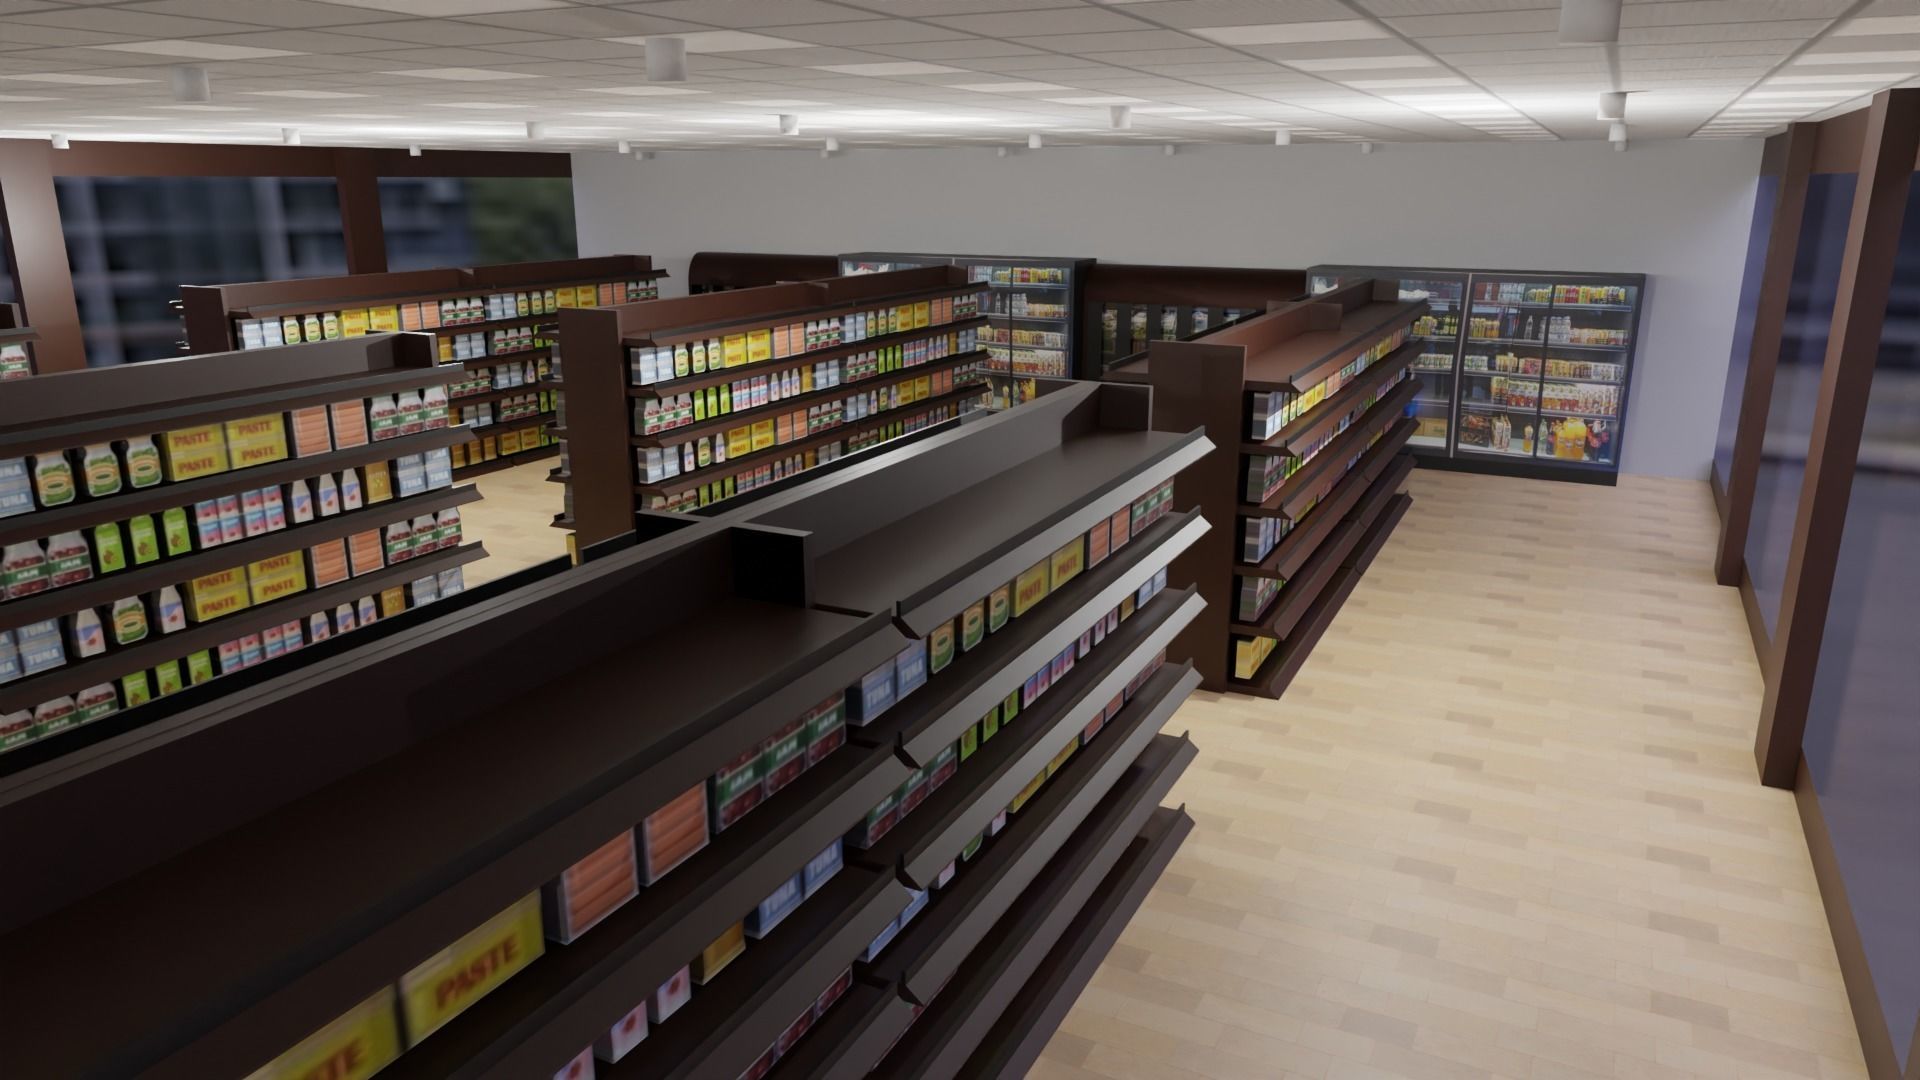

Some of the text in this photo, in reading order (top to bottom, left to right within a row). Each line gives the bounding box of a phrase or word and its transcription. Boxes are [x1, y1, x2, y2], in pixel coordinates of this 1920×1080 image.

[405, 413, 419, 422] JAM
[430, 409, 444, 417] JAM
[238, 421, 273, 436] PASTE
[174, 431, 210, 447] PASTE
[241, 445, 276, 462] PASTE
[177, 457, 214, 475] PASTE
[60, 558, 82, 569] JAM
[17, 568, 39, 580] JAM
[263, 578, 295, 597] PASTE
[200, 595, 236, 615] PASTE
[27, 648, 60, 666] TUNA
[901, 658, 923, 684] TUNA
[866, 679, 891, 710] TUNA
[89, 703, 110, 716] JAM
[47, 718, 69, 730] JAM
[818, 710, 837, 732] JAM
[5, 732, 27, 744] JAM
[776, 736, 798, 761] JAM
[730, 766, 754, 791] JAM
[435, 936, 517, 1011] PASTE
